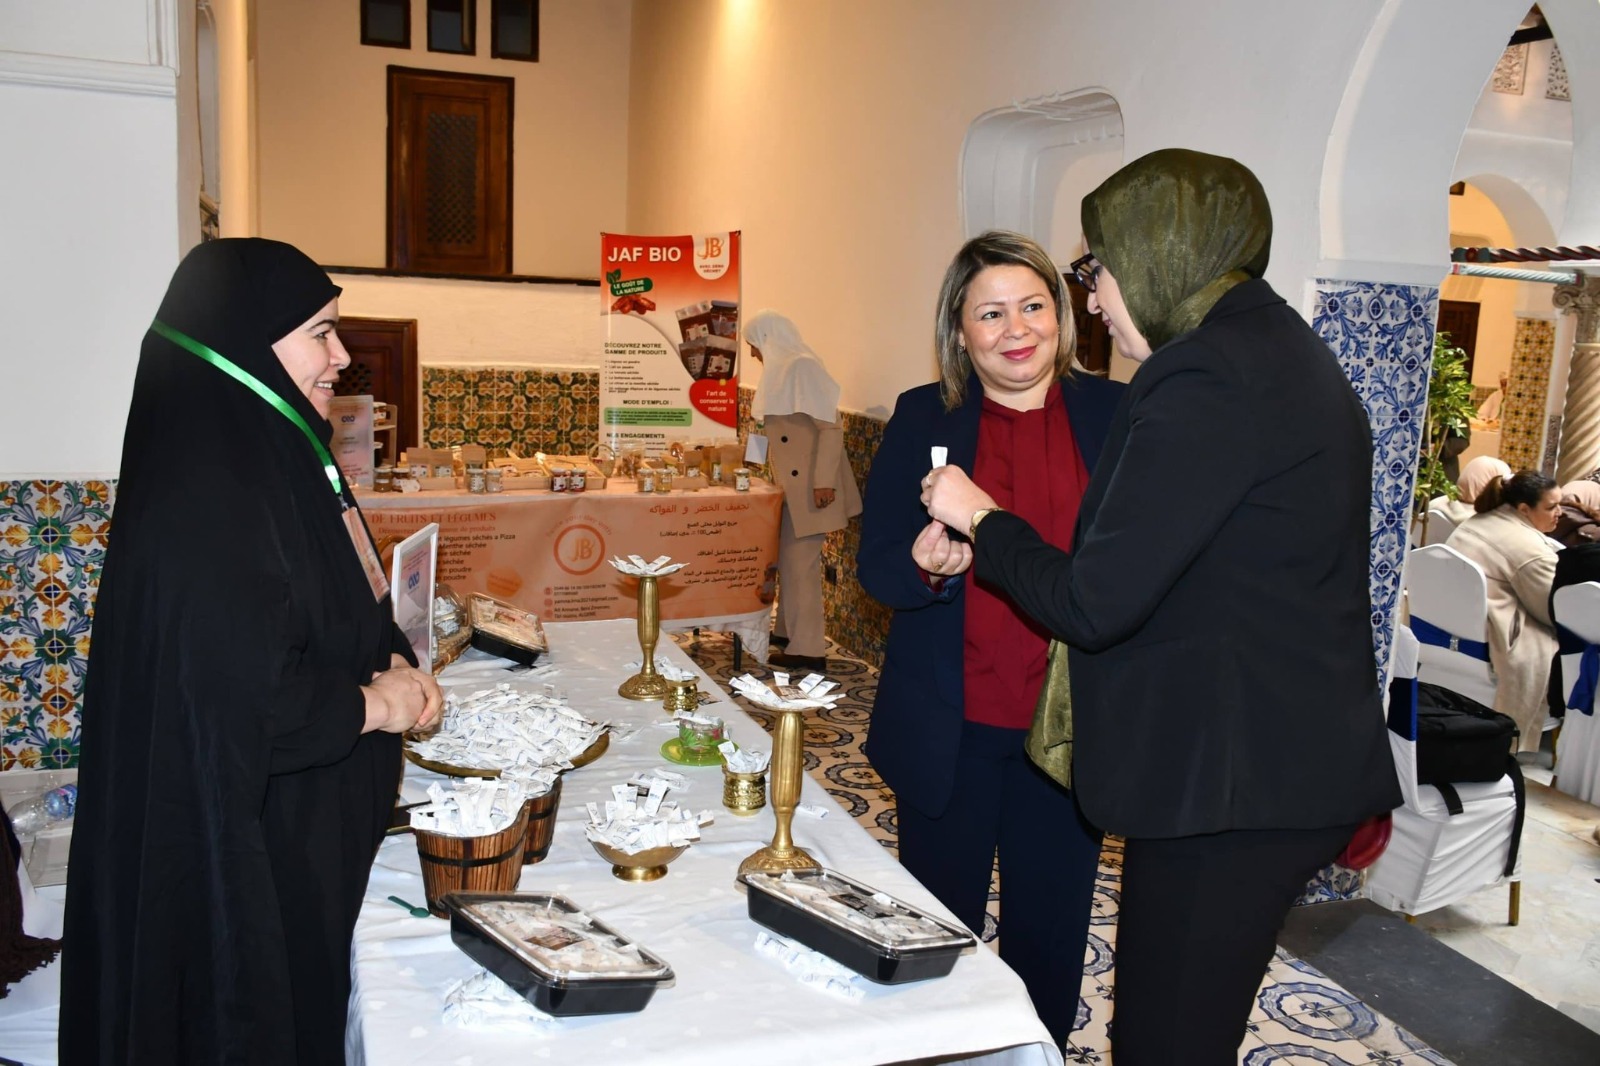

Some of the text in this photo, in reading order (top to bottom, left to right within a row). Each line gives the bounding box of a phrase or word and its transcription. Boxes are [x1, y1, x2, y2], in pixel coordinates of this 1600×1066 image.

[697, 237, 724, 260] JB
[608, 247, 681, 262] JAF BIO
[682, 506, 688, 514] و
[694, 504, 719, 514] الخضر
[725, 503, 750, 512] تجفيف
[372, 512, 496, 523] DE FRUITS ET LÉGUMES
